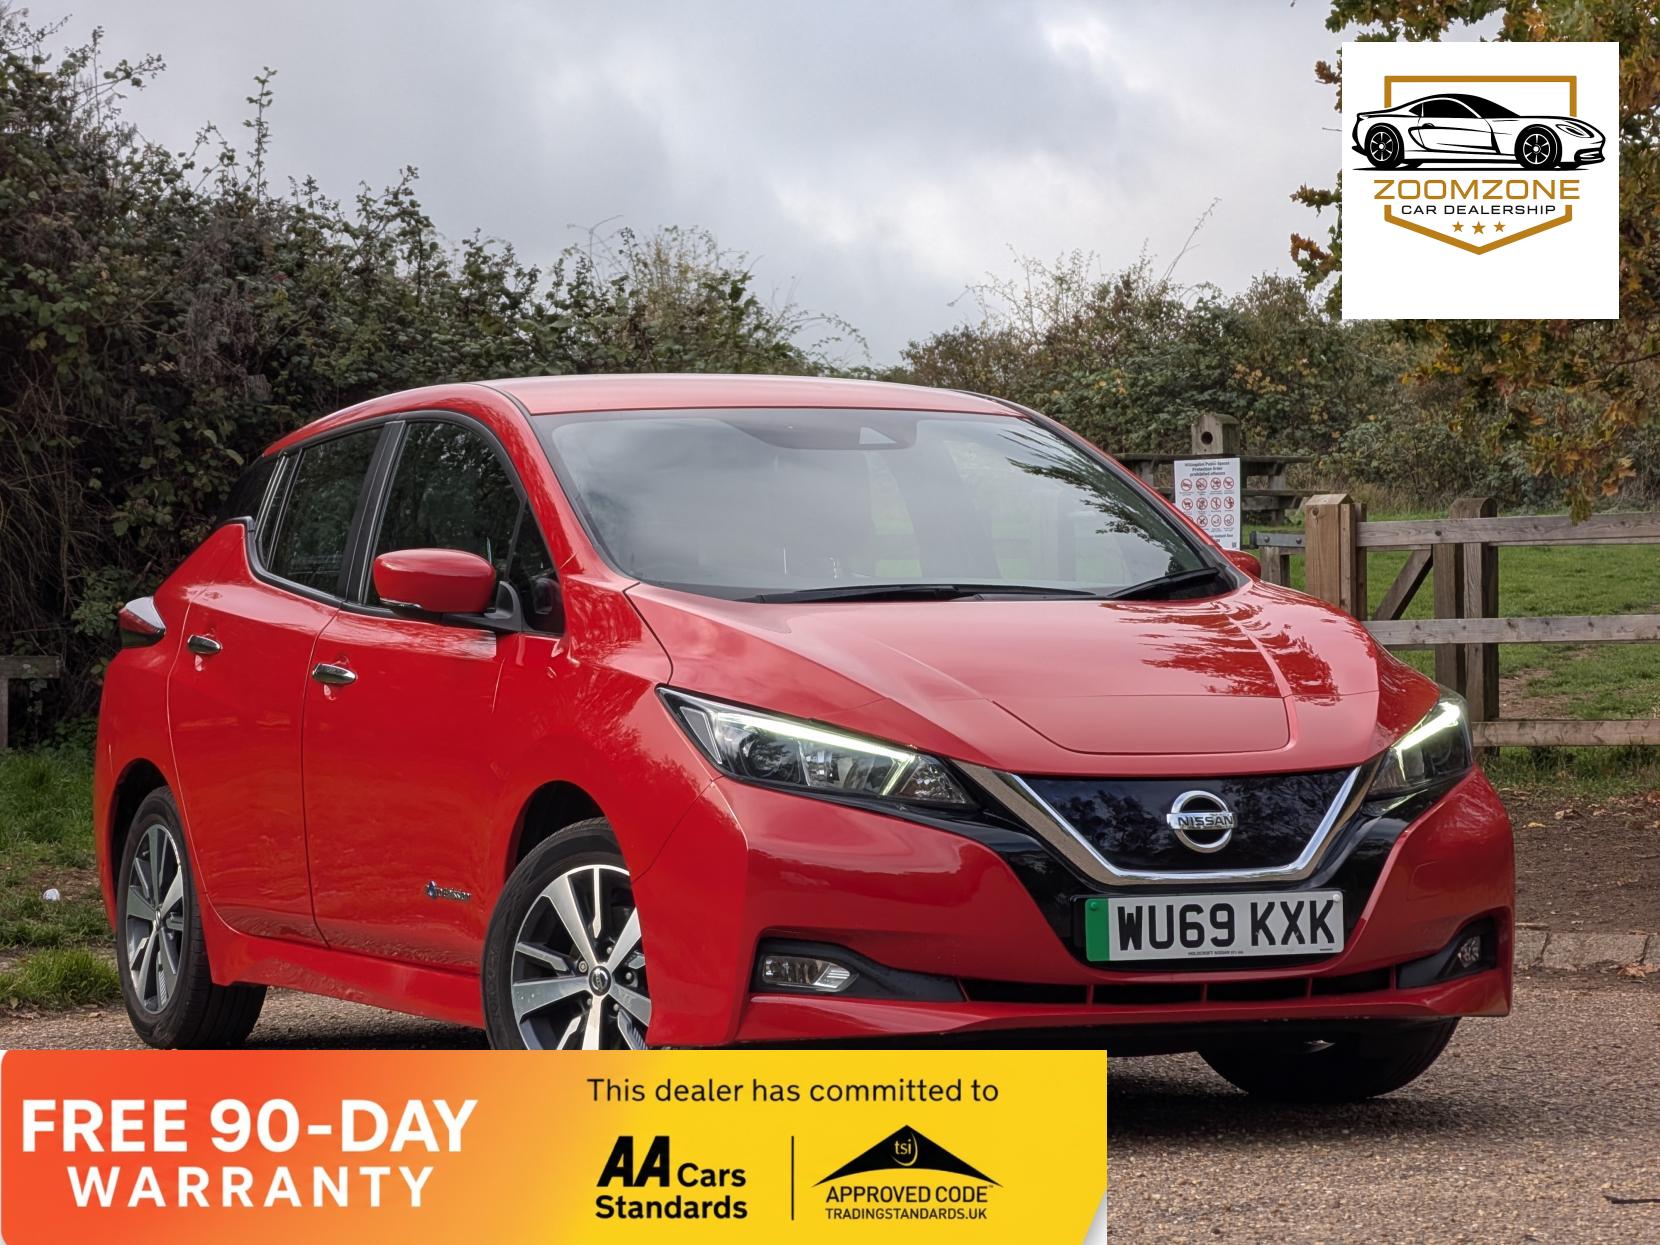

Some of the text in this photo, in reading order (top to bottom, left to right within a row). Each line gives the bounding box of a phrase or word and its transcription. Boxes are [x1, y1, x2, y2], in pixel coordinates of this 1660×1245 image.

[1177, 815, 1233, 826] NISSAN
[1116, 899, 1336, 951] WU69 KXK
